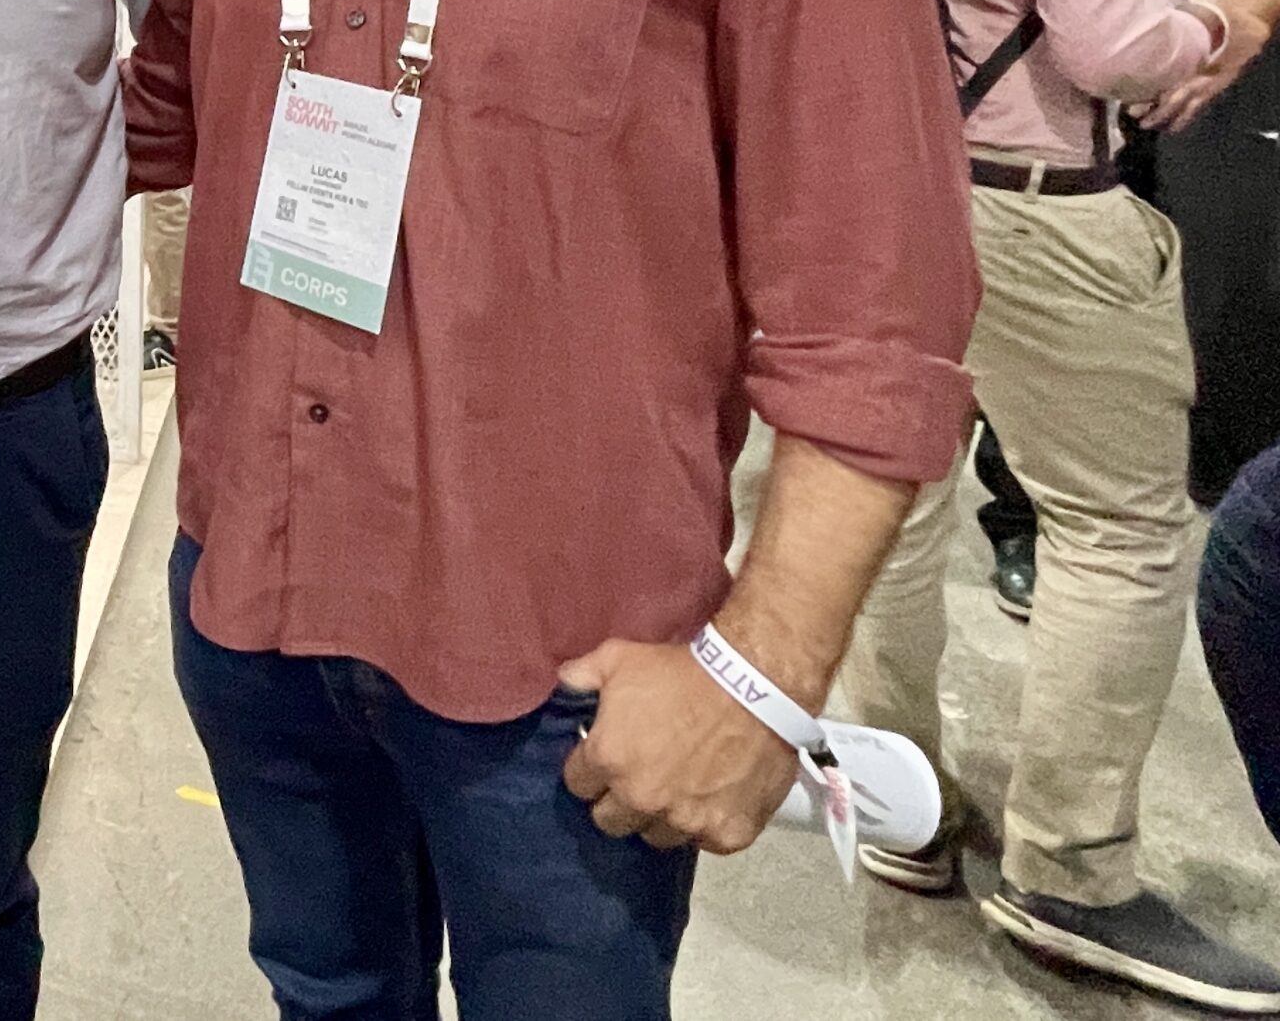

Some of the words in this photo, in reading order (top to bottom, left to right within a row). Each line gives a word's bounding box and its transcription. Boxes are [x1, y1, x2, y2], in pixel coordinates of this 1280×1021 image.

[287, 95, 334, 118] SOUTH
[284, 107, 340, 134] SUMMIT
[310, 163, 348, 184] LUCAS
[280, 267, 349, 307] CORPS
